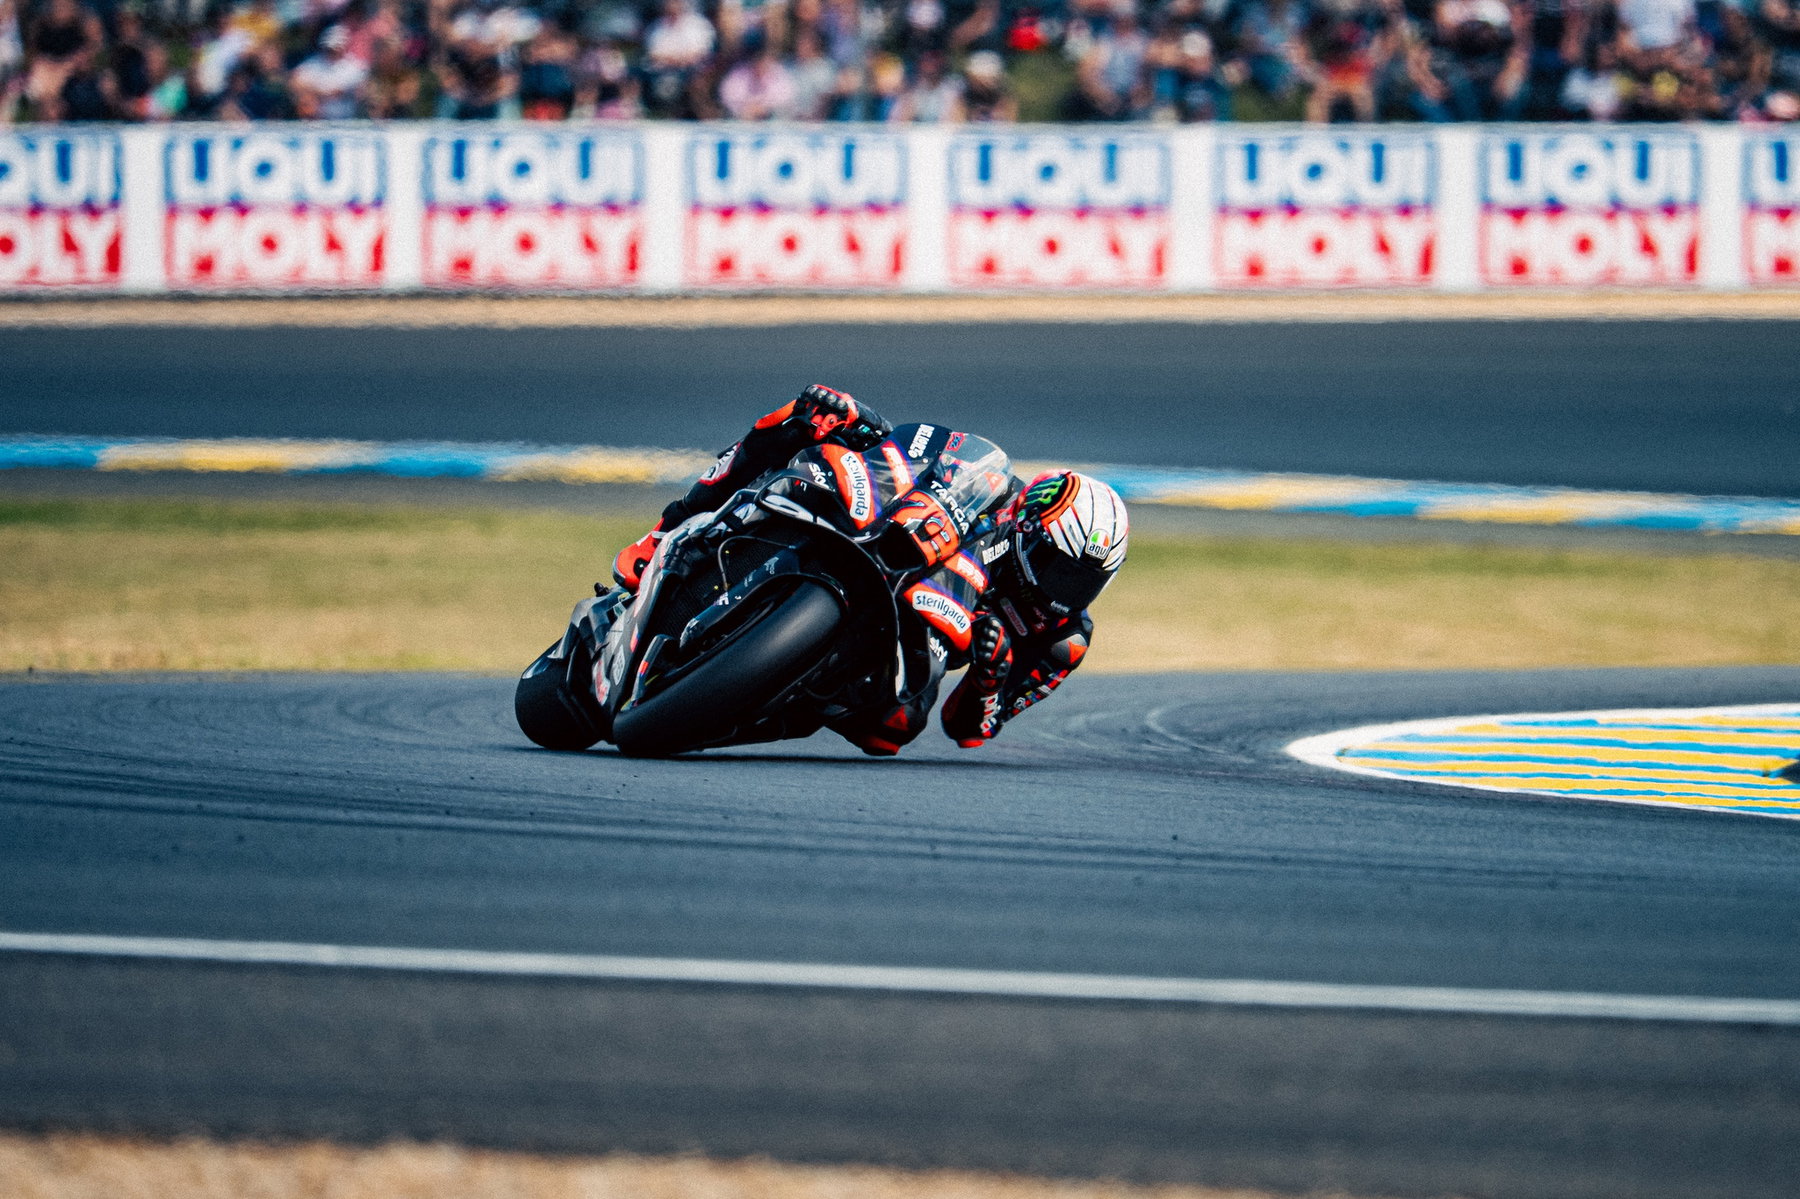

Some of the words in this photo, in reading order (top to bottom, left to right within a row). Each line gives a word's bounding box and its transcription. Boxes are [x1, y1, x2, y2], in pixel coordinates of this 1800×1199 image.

[173, 206, 381, 281] MOLY
[432, 206, 640, 281] MOLY
[695, 206, 903, 281] MOLY
[957, 206, 1165, 281] MOLY
[1225, 206, 1433, 281] MOLY
[1488, 206, 1696, 281] MOLY
[846, 455, 867, 517] sterilgarda
[930, 480, 970, 536] TARGA
[1088, 544, 1107, 557] agv
[915, 594, 967, 631] sterilgarda
[928, 637, 948, 662] sky
